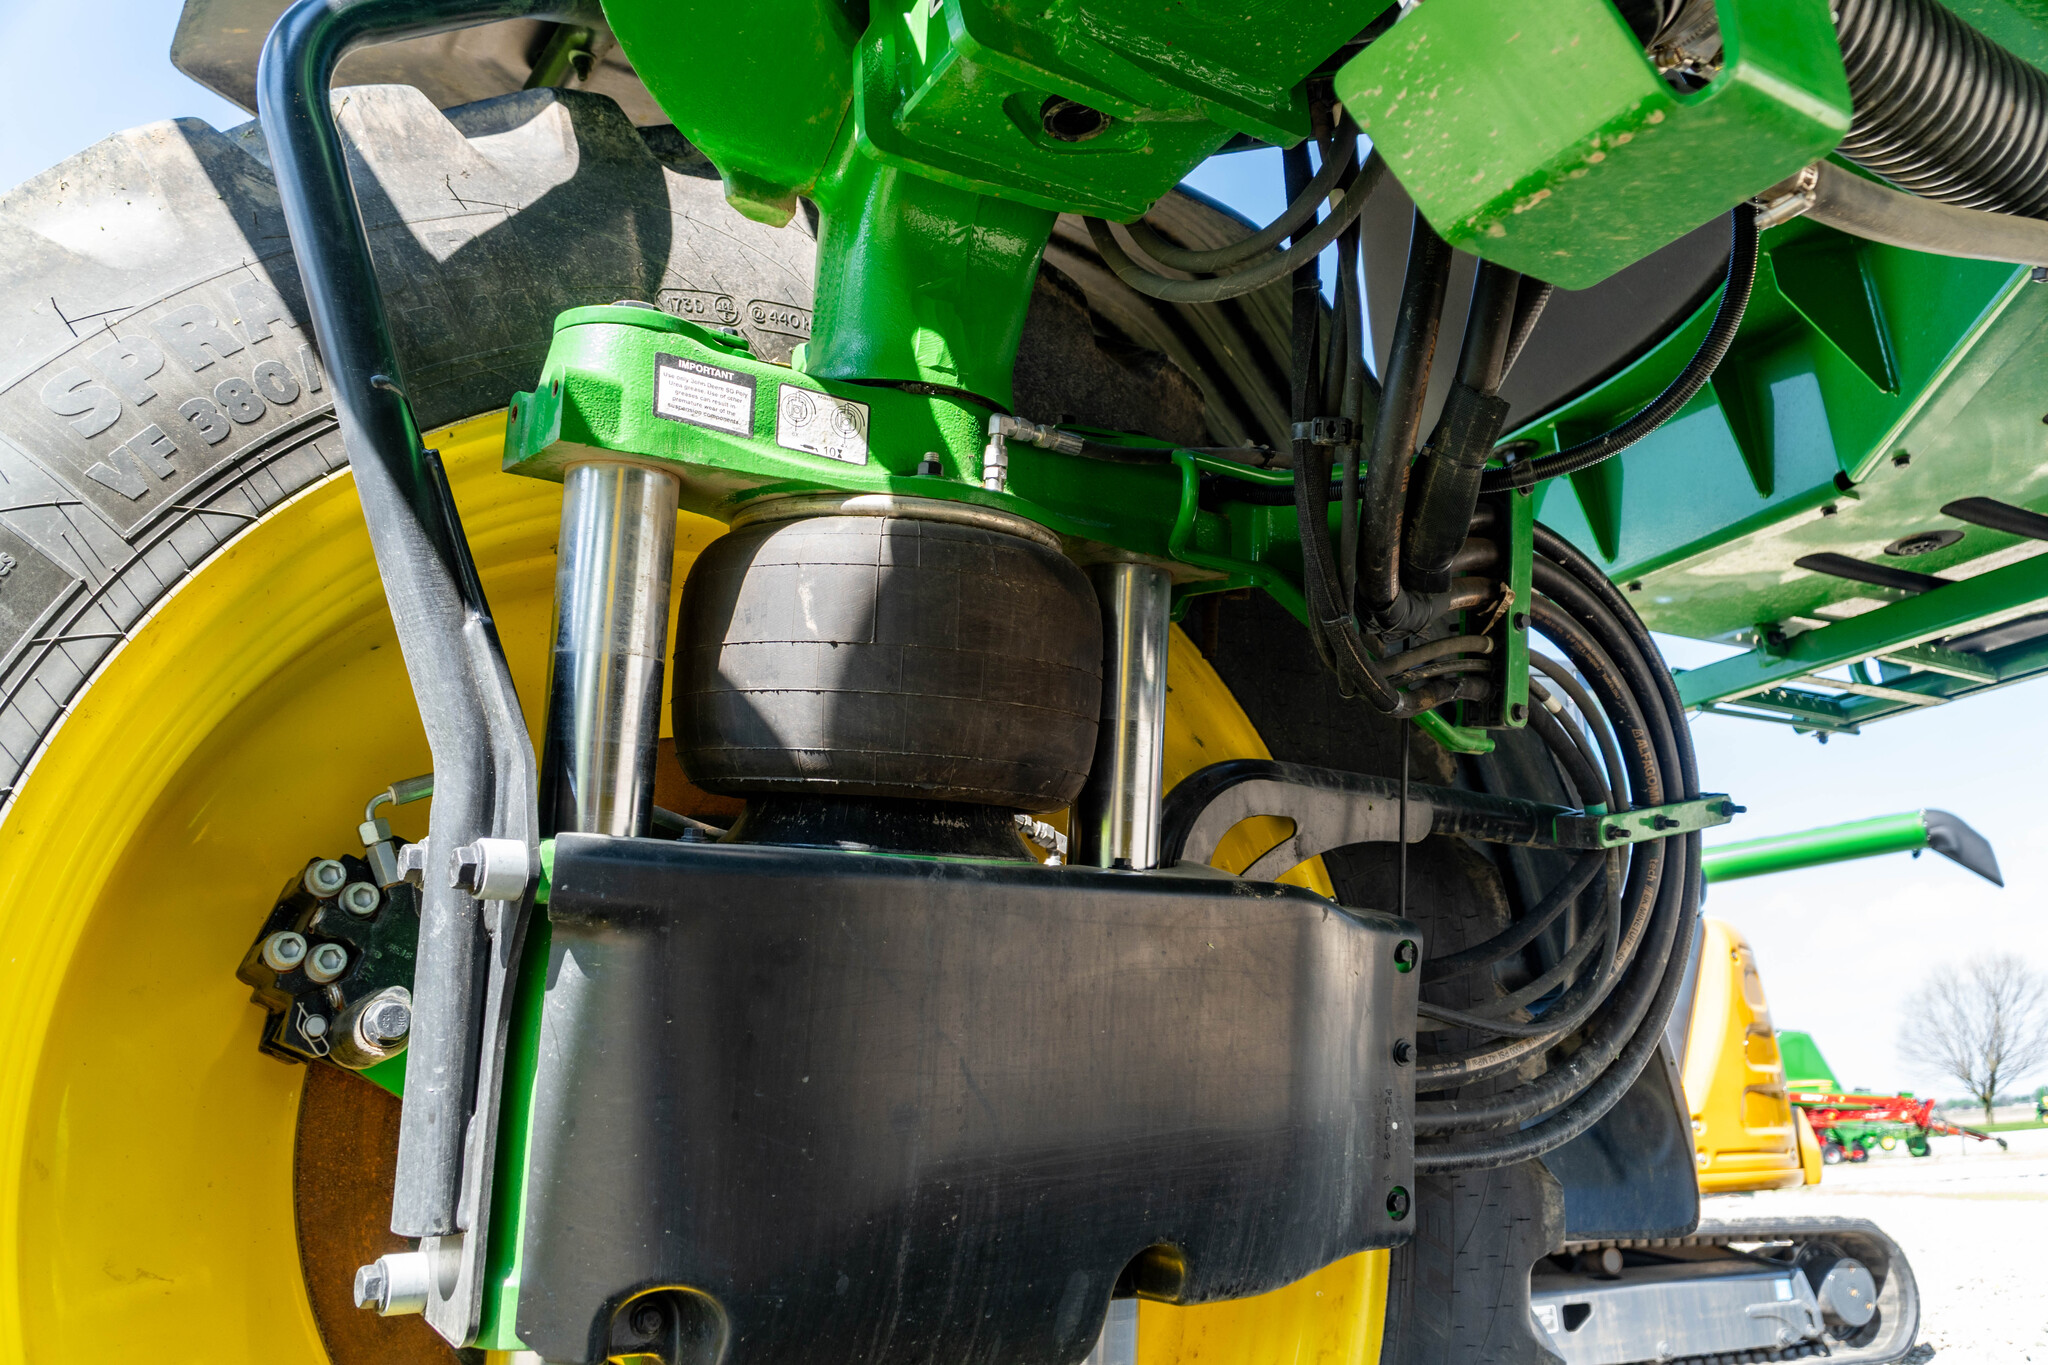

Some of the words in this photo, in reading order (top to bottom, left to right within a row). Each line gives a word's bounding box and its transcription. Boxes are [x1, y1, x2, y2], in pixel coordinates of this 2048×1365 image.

[666, 296, 705, 314] 173D
[769, 310, 801, 330] 440
[40, 278, 301, 440] SPRA
[678, 359, 735, 381] IMPORTANT
[663, 371, 675, 379] Use
[676, 375, 689, 384] only
[690, 378, 706, 387] John
[707, 382, 725, 391] Deere
[735, 389, 749, 399] Poly
[668, 380, 683, 388] Urea
[684, 384, 704, 393] grease.
[707, 390, 718, 398] Use
[727, 395, 743, 404] other
[672, 396, 703, 409] premature
[674, 389, 699, 401] greases
[712, 398, 729, 408] result
[84, 423, 178, 501] VF
[178, 343, 322, 446] 380/
[667, 402, 703, 415] suspension
[703, 411, 741, 425] components.
[824, 446, 836, 457] 10
[1635, 738, 1661, 807] ALFAGOMM
[1646, 858, 1659, 882] tech
[1625, 907, 1648, 946] MINETUFF
